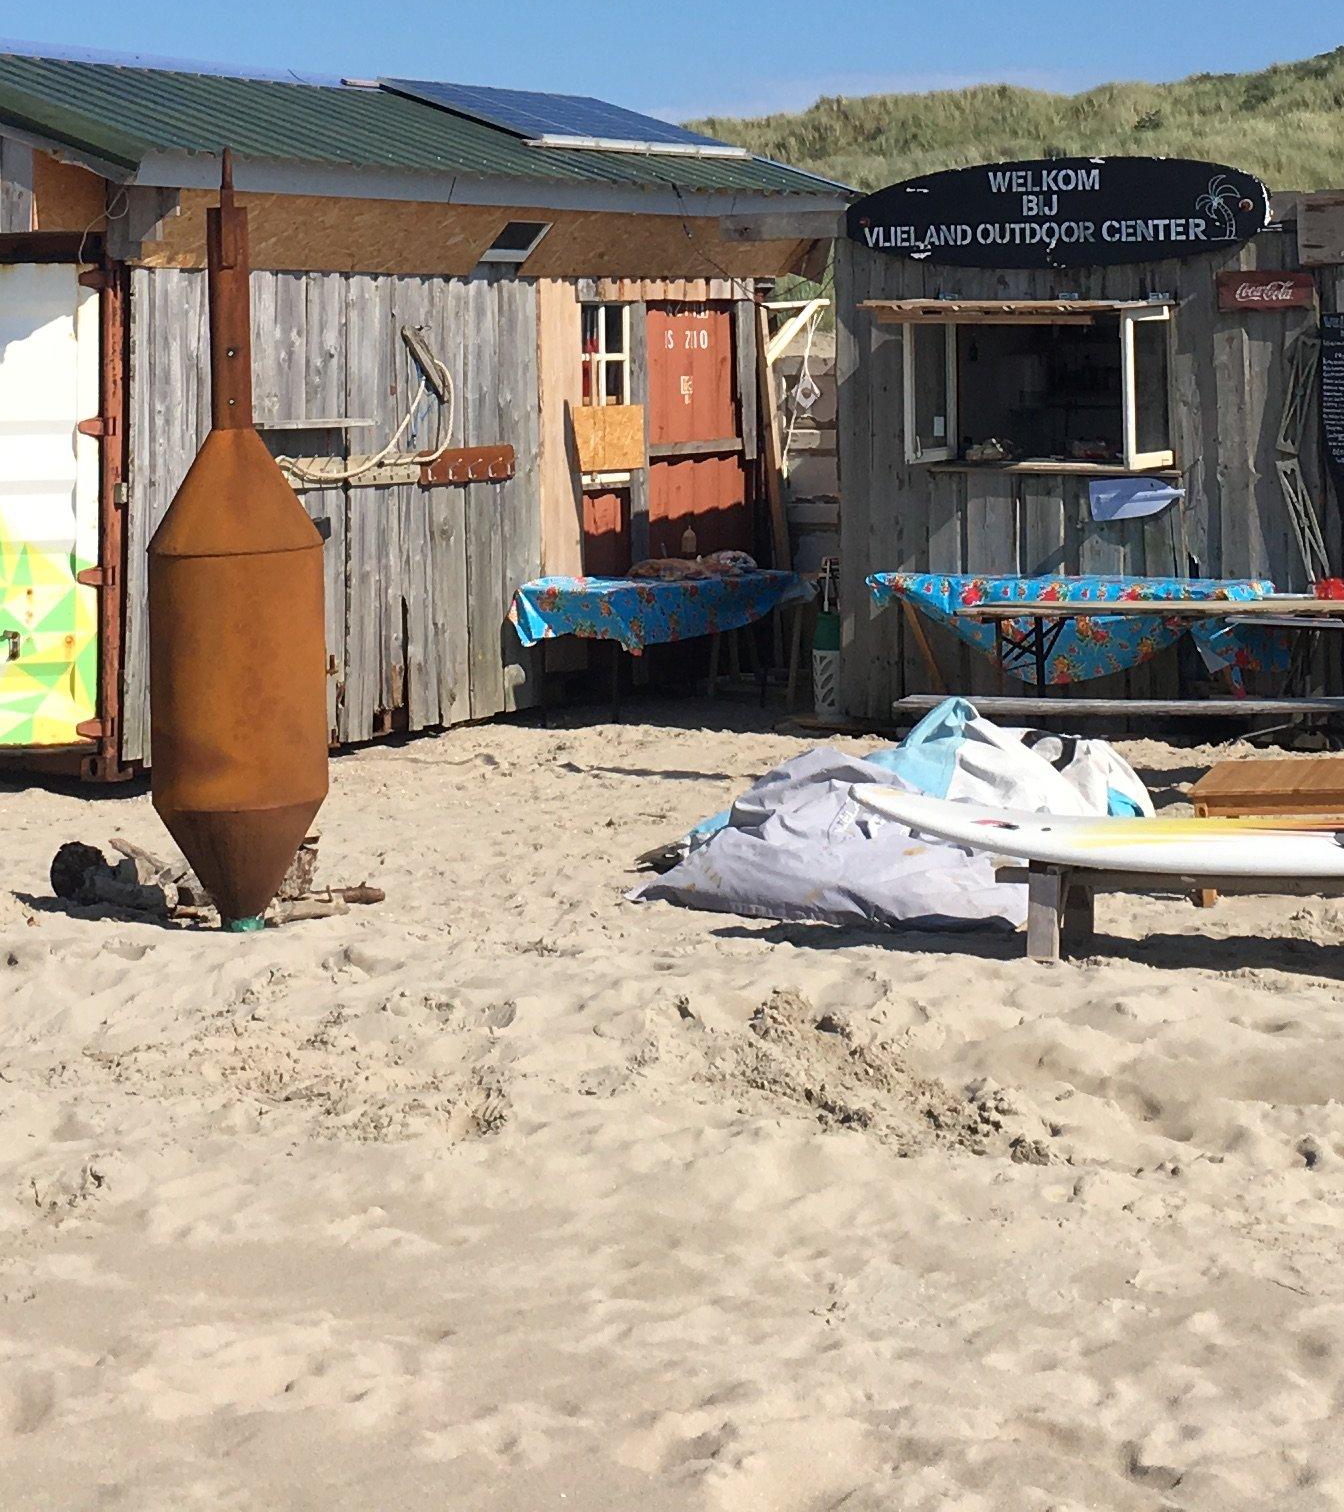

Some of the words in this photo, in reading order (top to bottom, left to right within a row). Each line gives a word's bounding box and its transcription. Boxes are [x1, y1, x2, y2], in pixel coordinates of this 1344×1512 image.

[988, 169, 1100, 193] WELKOM
[1022, 194, 1058, 216] BIJ
[864, 224, 973, 248] VLIELAND
[977, 221, 1096, 245] OUTDOOR
[1102, 218, 1207, 242] CENTER
